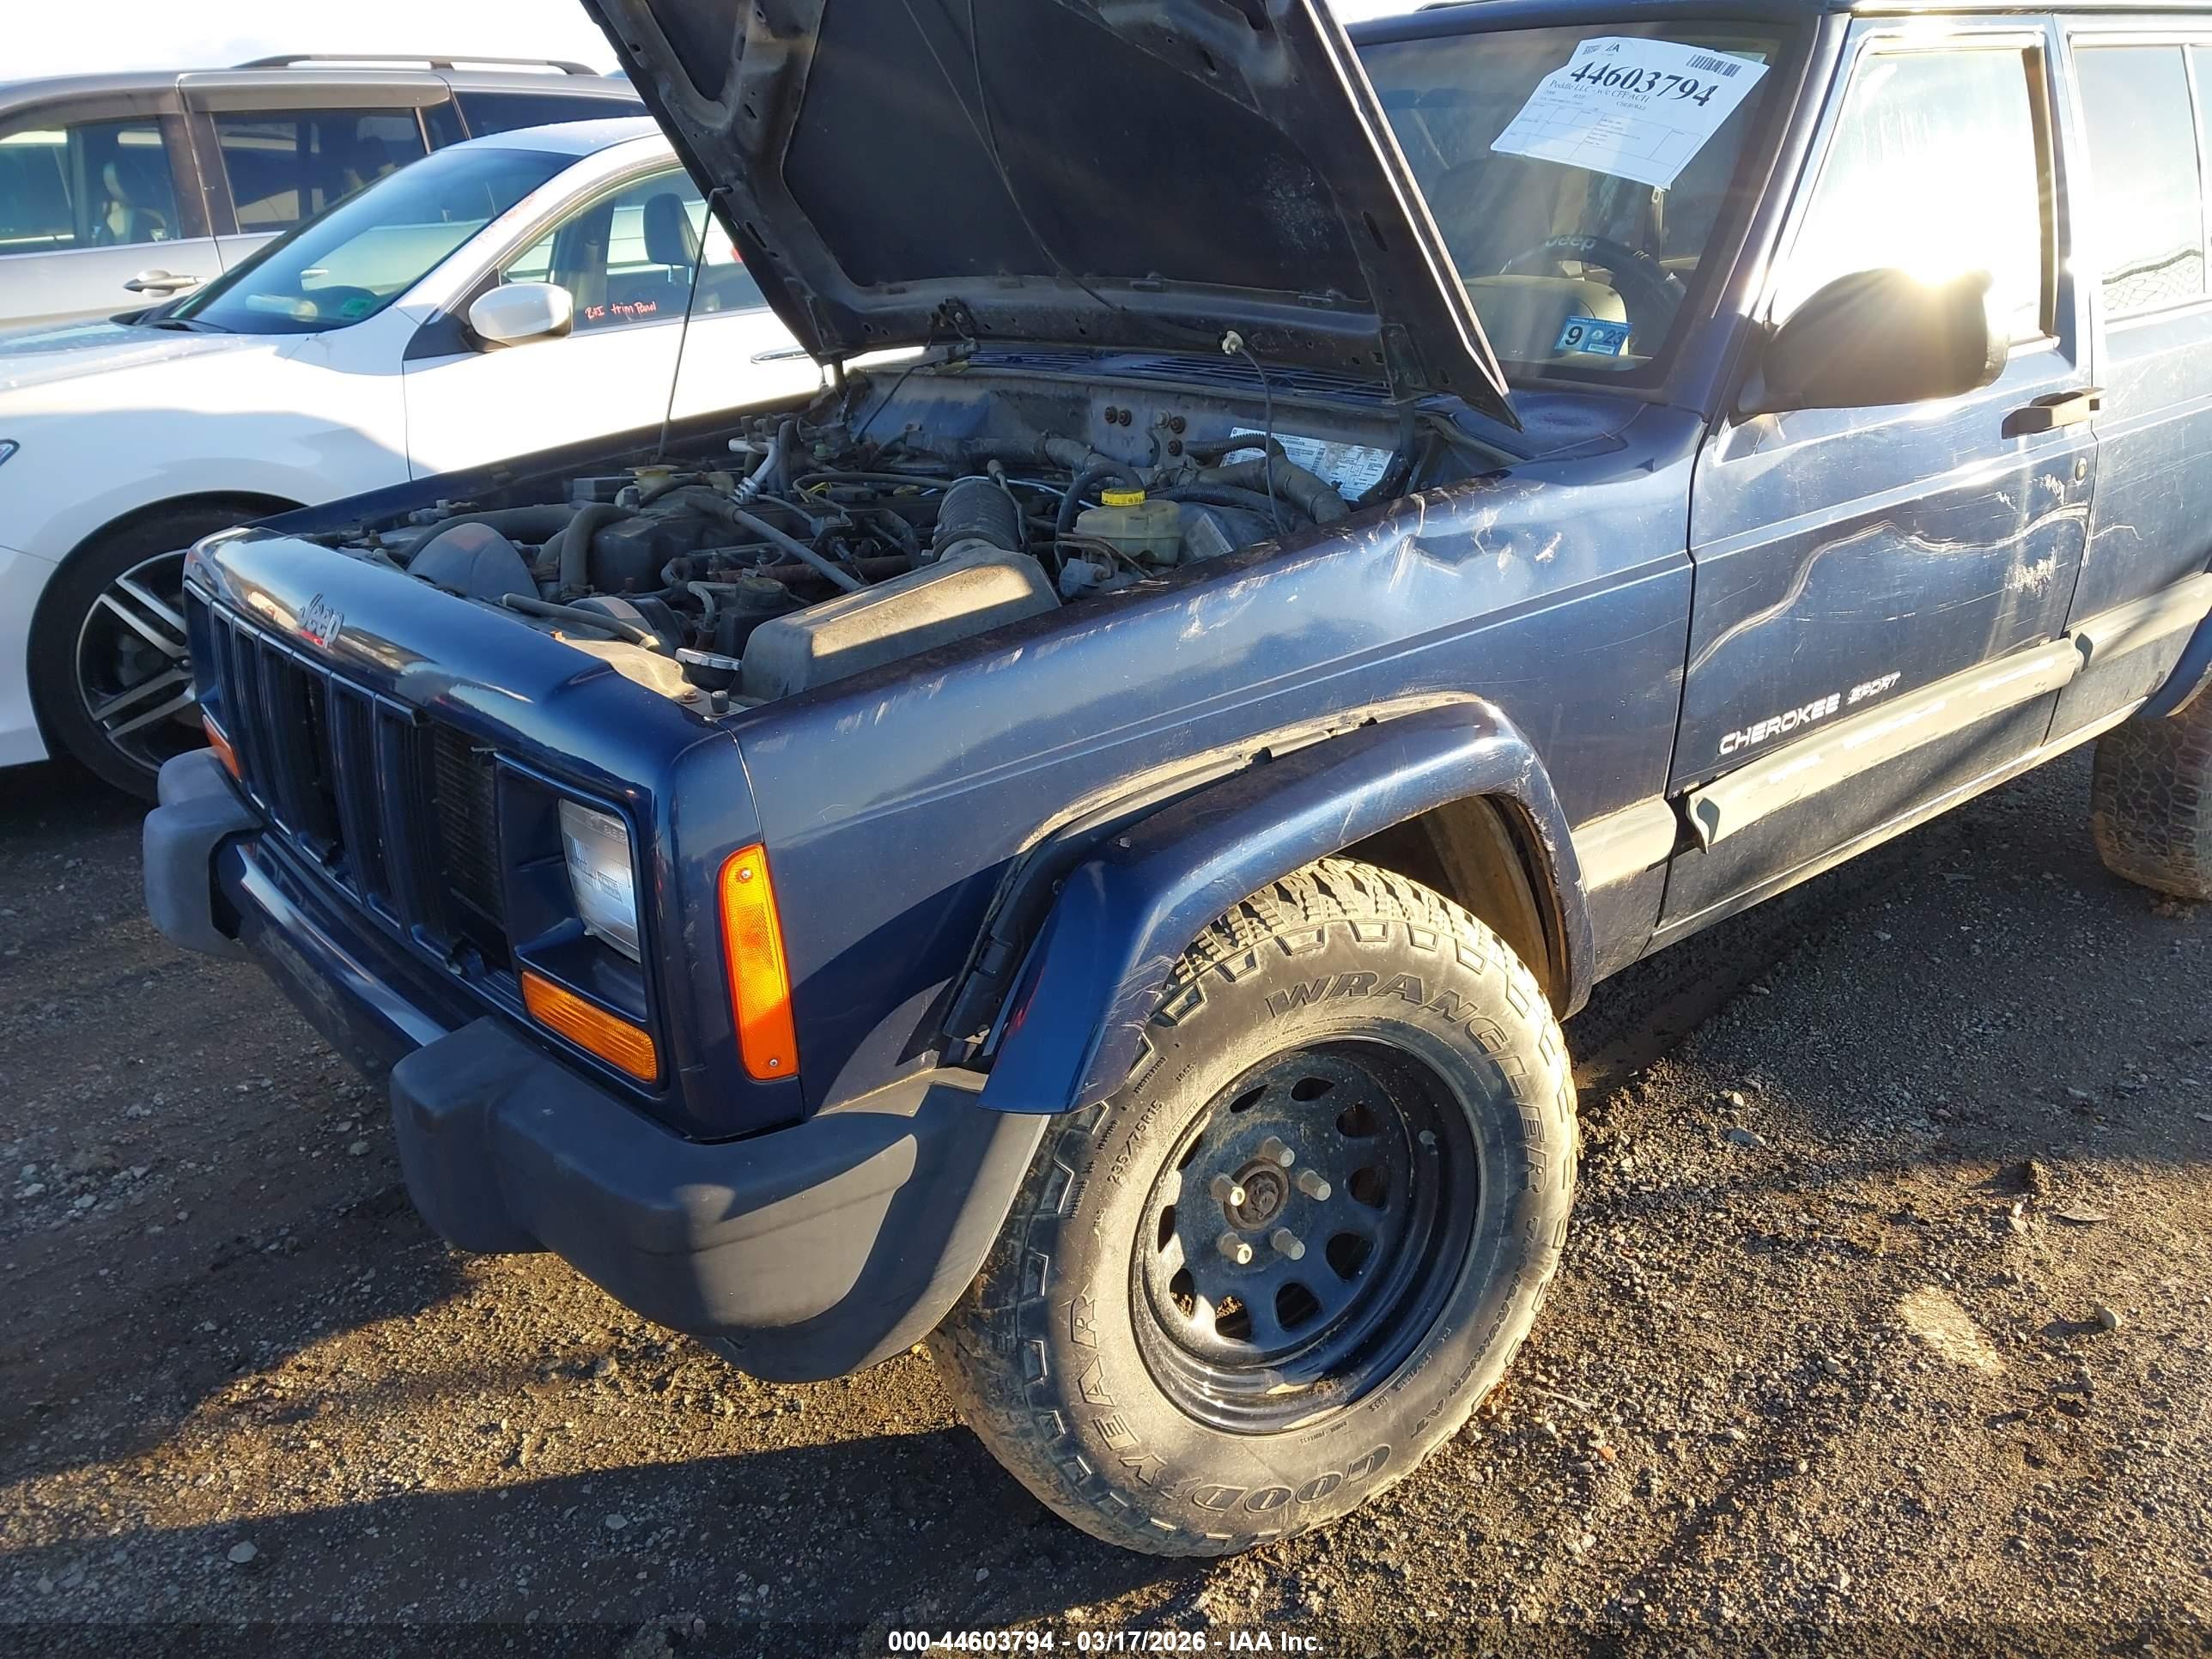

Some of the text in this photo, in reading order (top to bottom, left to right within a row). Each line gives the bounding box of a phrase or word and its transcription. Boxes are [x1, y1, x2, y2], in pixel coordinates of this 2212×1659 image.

[1570, 61, 1719, 106] 44603794
[611, 301, 634, 315] trim
[1565, 325, 1583, 346] 9
[1718, 671, 1902, 756] CHEROKEE SPORT
[1265, 970, 1547, 1194] WRANGLER
